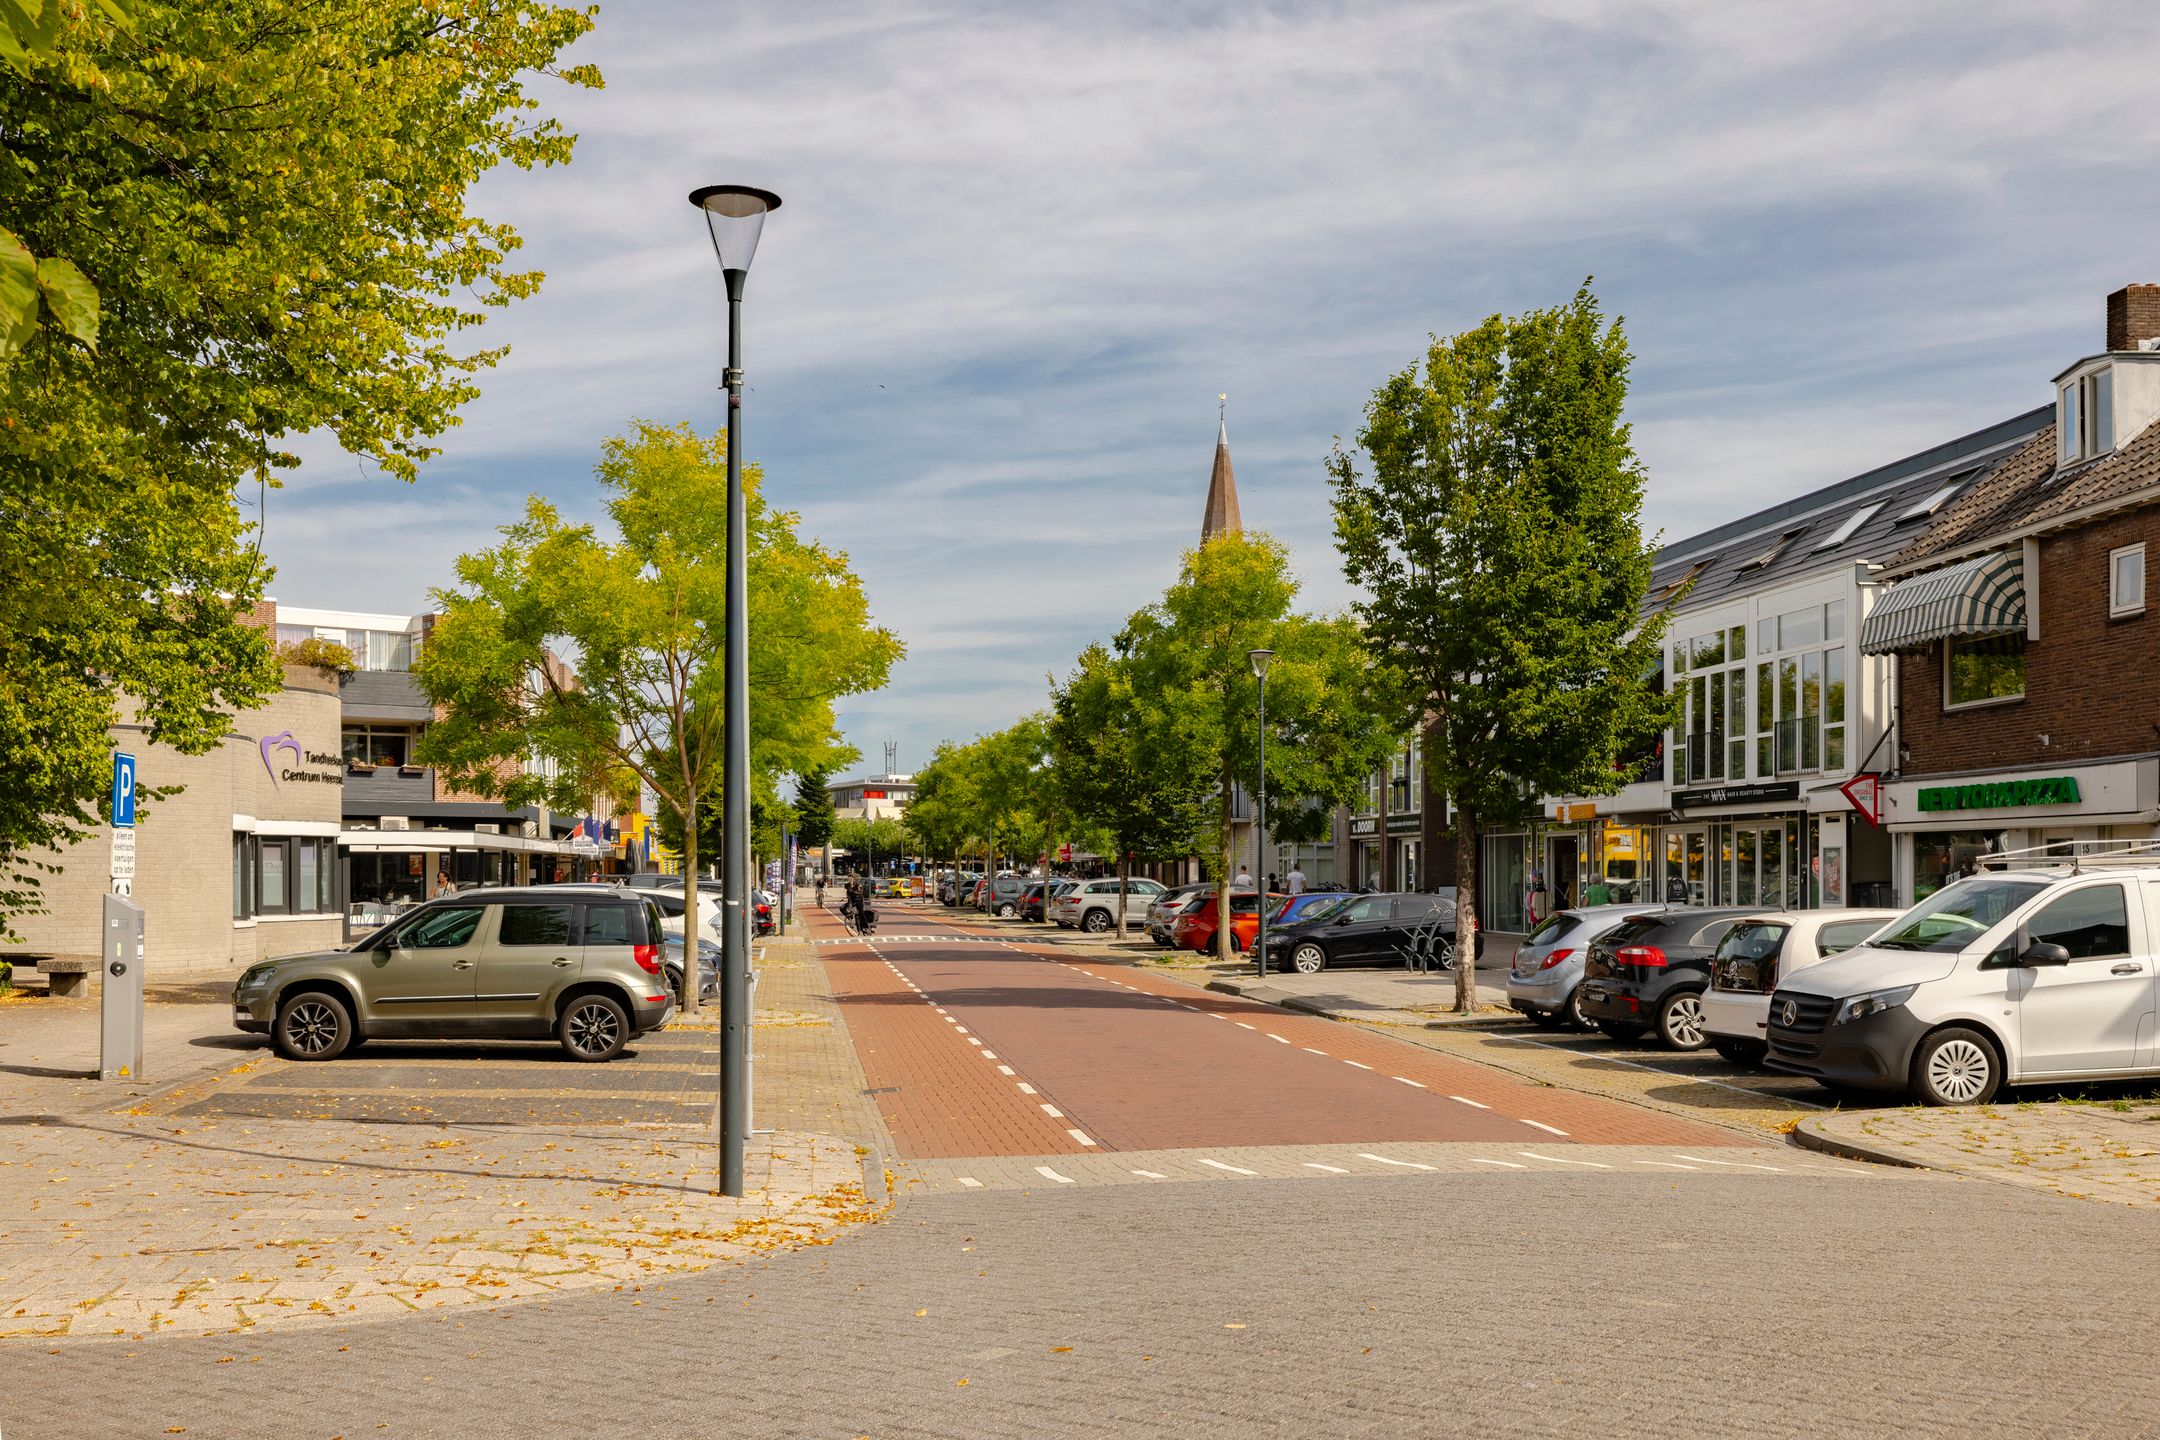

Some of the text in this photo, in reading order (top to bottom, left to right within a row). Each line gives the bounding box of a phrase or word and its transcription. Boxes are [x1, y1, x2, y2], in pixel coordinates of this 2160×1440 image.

[282, 769, 320, 782] Centrum
[120, 764, 131, 816] P
[1710, 788, 1727, 802] WAX
[1918, 776, 2081, 811] NEW YORK PIZZA
